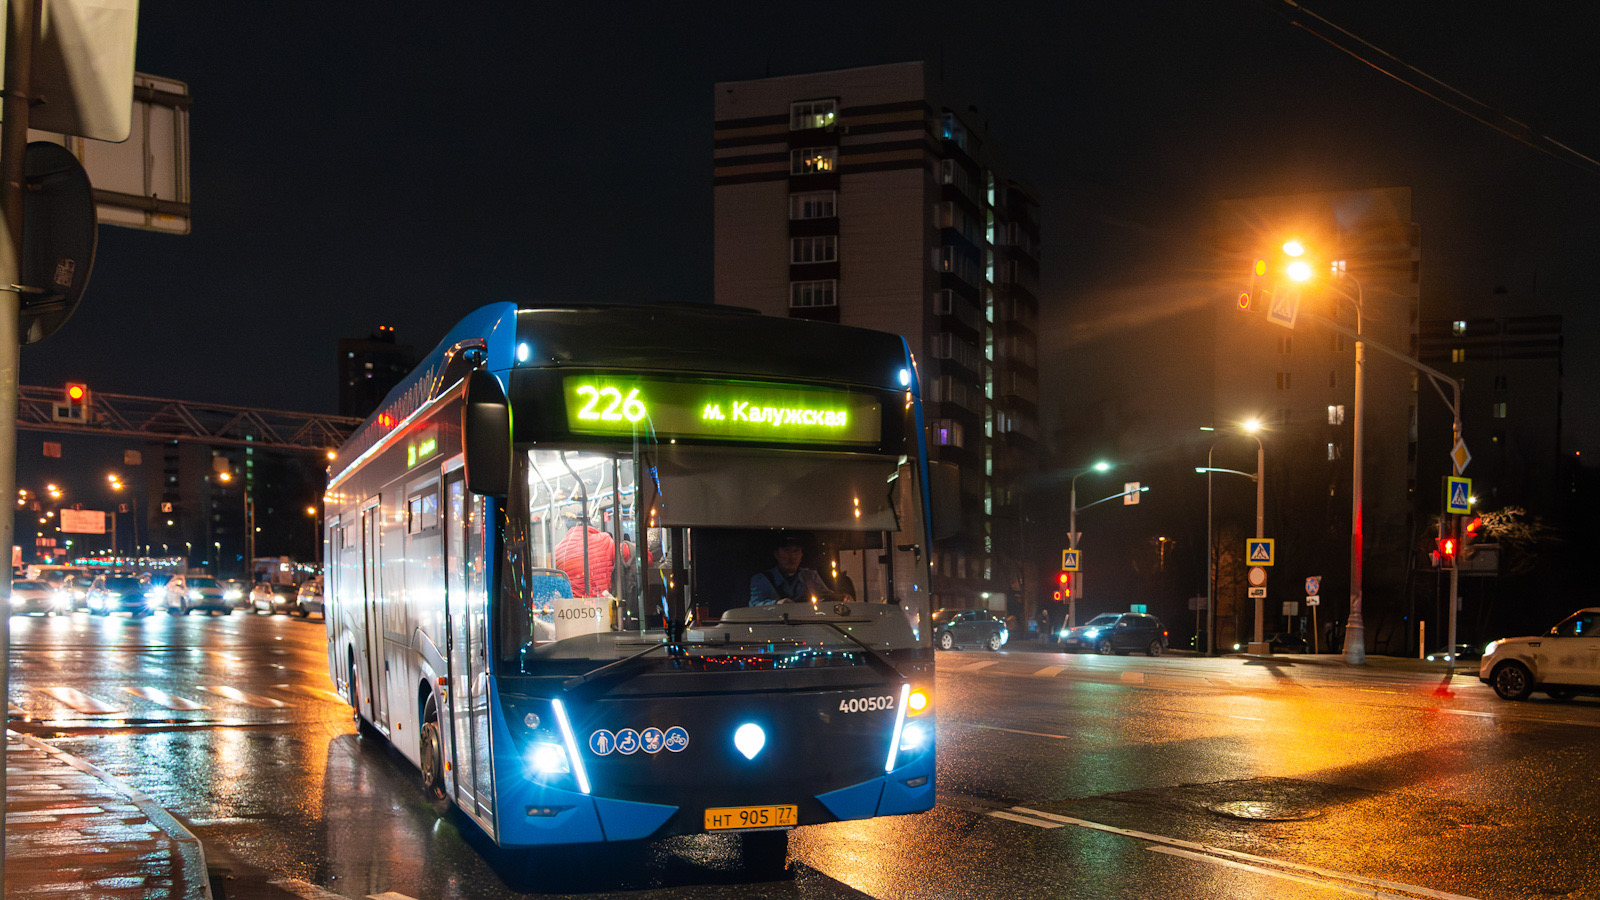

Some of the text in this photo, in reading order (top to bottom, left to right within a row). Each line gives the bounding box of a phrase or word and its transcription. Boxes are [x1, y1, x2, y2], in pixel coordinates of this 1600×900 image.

[576, 384, 648, 423] 226
[703, 401, 848, 427] м. Калужская
[838, 695, 895, 714] 400502
[739, 809, 769, 826] 905
[778, 807, 792, 819] 77
